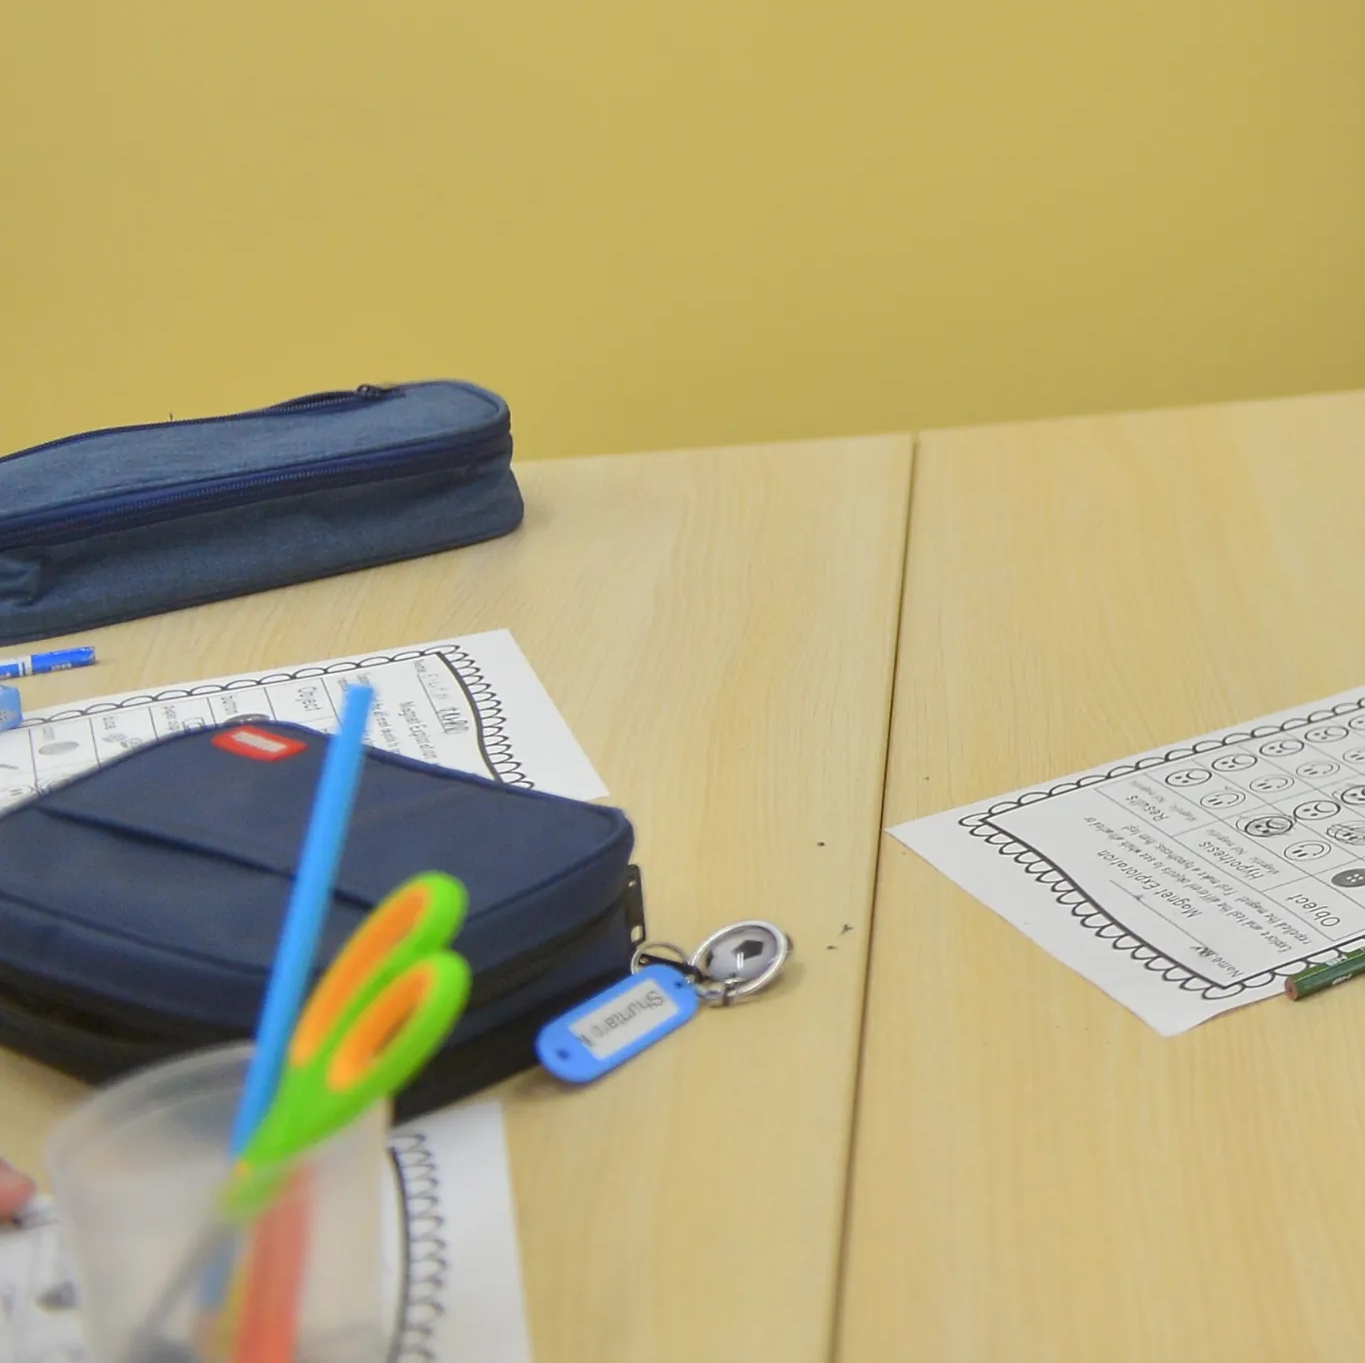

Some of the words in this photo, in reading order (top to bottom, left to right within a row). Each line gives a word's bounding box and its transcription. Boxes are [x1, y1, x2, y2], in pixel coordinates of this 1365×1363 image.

[1125, 794, 1170, 822] Results
[1138, 852, 1157, 863] see
[1152, 861, 1165, 869] to
[1197, 841, 1265, 881] Hypothesis
[1096, 849, 1161, 890] Exploration
[1160, 866, 1192, 884] objects
[1196, 871, 1221, 885] make
[1152, 888, 1203, 918] Magnet
[1182, 883, 1222, 904] different
[1216, 901, 1234, 913] the
[1285, 893, 1341, 928] Object
[1240, 919, 1264, 931] and
[1263, 912, 1283, 924] the
[1259, 930, 1293, 953] Explore
[1273, 921, 1313, 945] repelled
